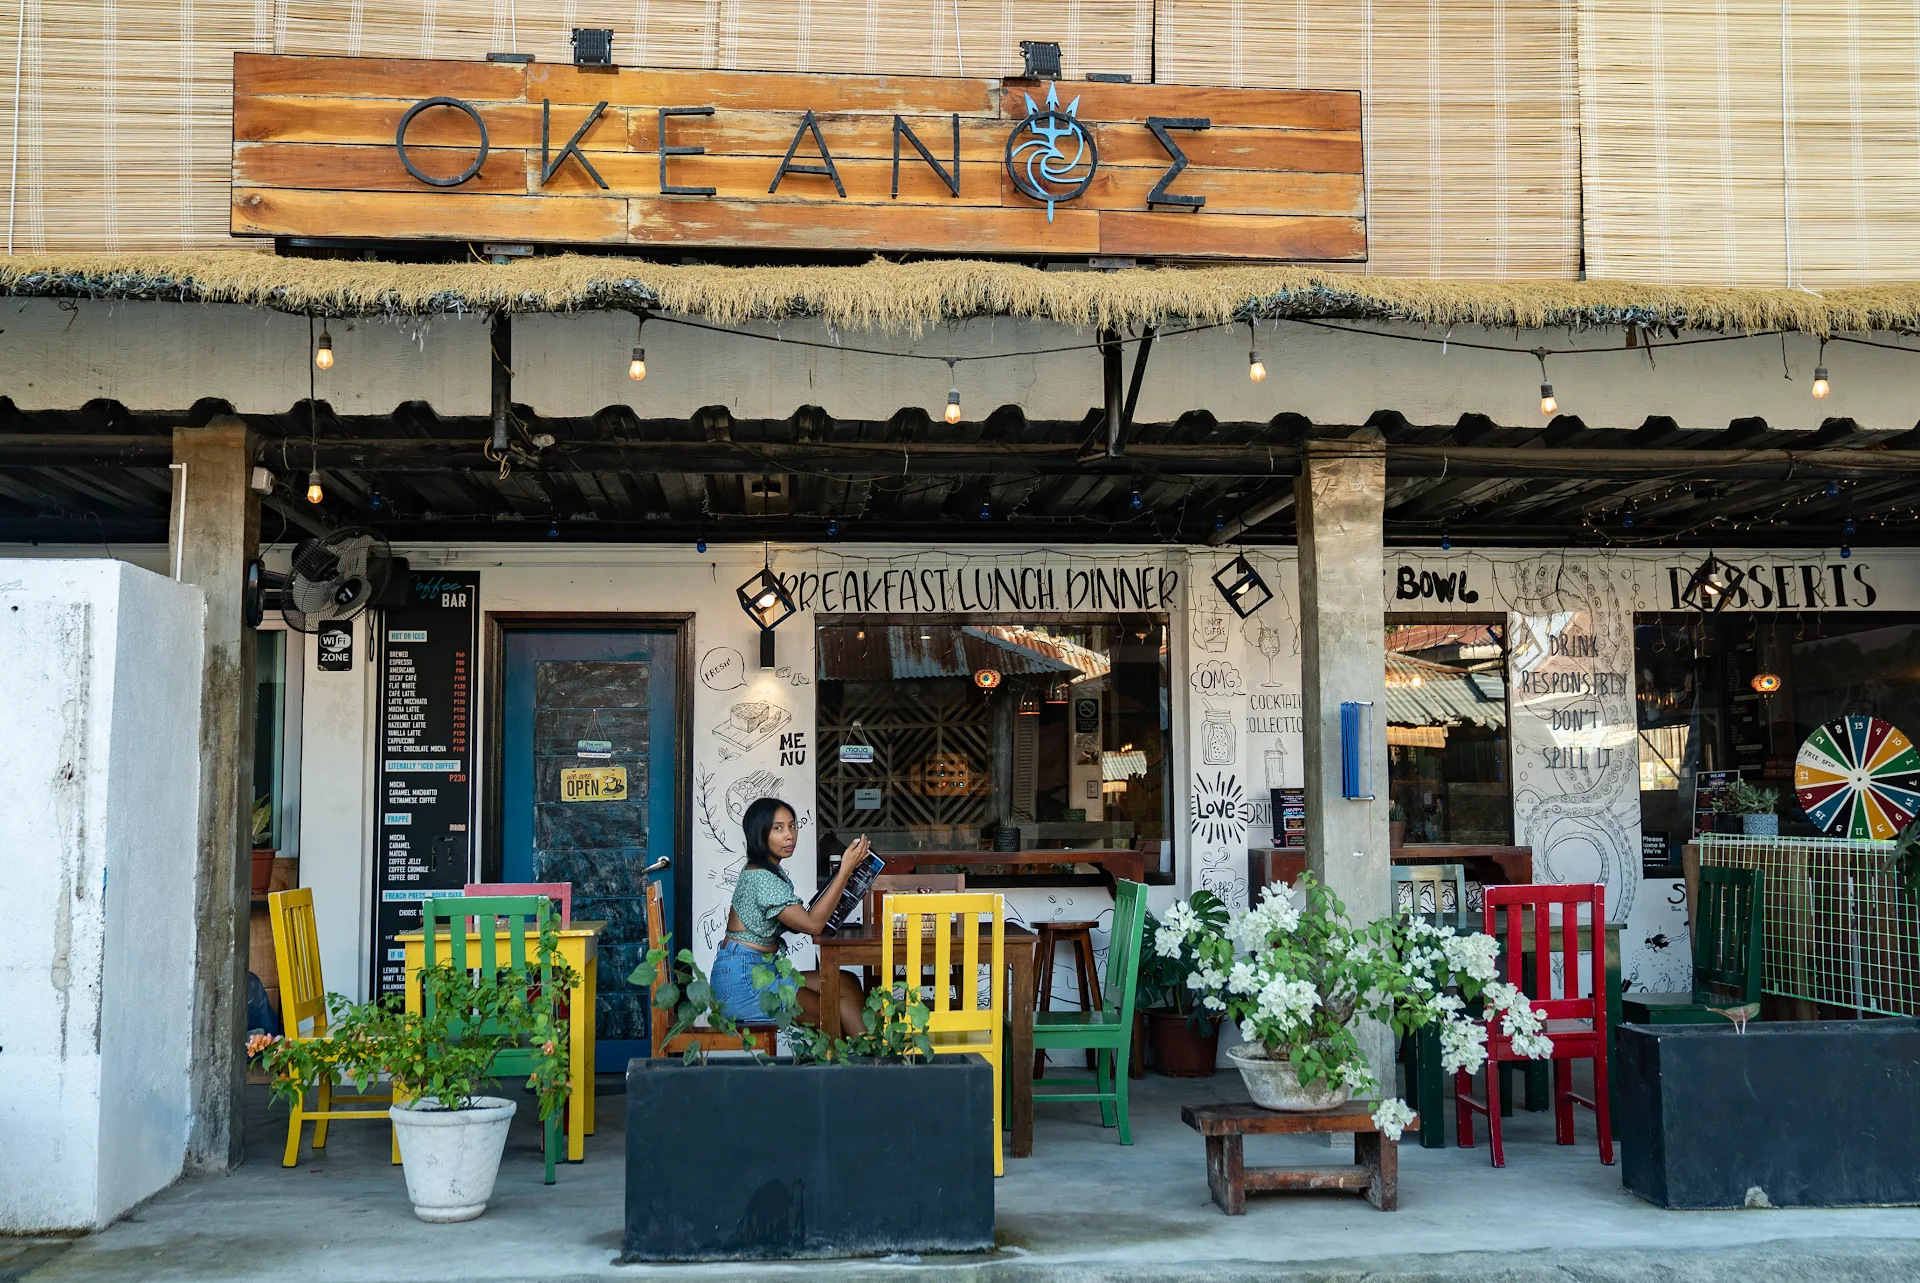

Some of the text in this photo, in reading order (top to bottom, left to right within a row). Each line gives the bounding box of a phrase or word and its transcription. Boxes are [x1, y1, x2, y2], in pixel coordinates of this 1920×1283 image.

[1396, 566, 1479, 604] BOWL
[442, 593, 466, 608] BAR
[1549, 634, 1599, 657] DRINK
[320, 653, 350, 662] ZONE
[705, 658, 731, 681] FRESH!
[1201, 669, 1235, 689] OMG
[1246, 717, 1303, 733] OLLECTIO
[1835, 724, 1842, 734] 8
[1876, 728, 1882, 736] 4
[779, 733, 806, 750] ME
[1892, 737, 1902, 746] 10
[780, 750, 805, 766] NU
[1543, 747, 1613, 769] SPILL IT
[1804, 750, 1818, 761] FREE
[1800, 770, 1808, 780] 12
[567, 780, 599, 796] OPEN
[1815, 810, 1826, 820] 15
[1876, 824, 1884, 832] 3
